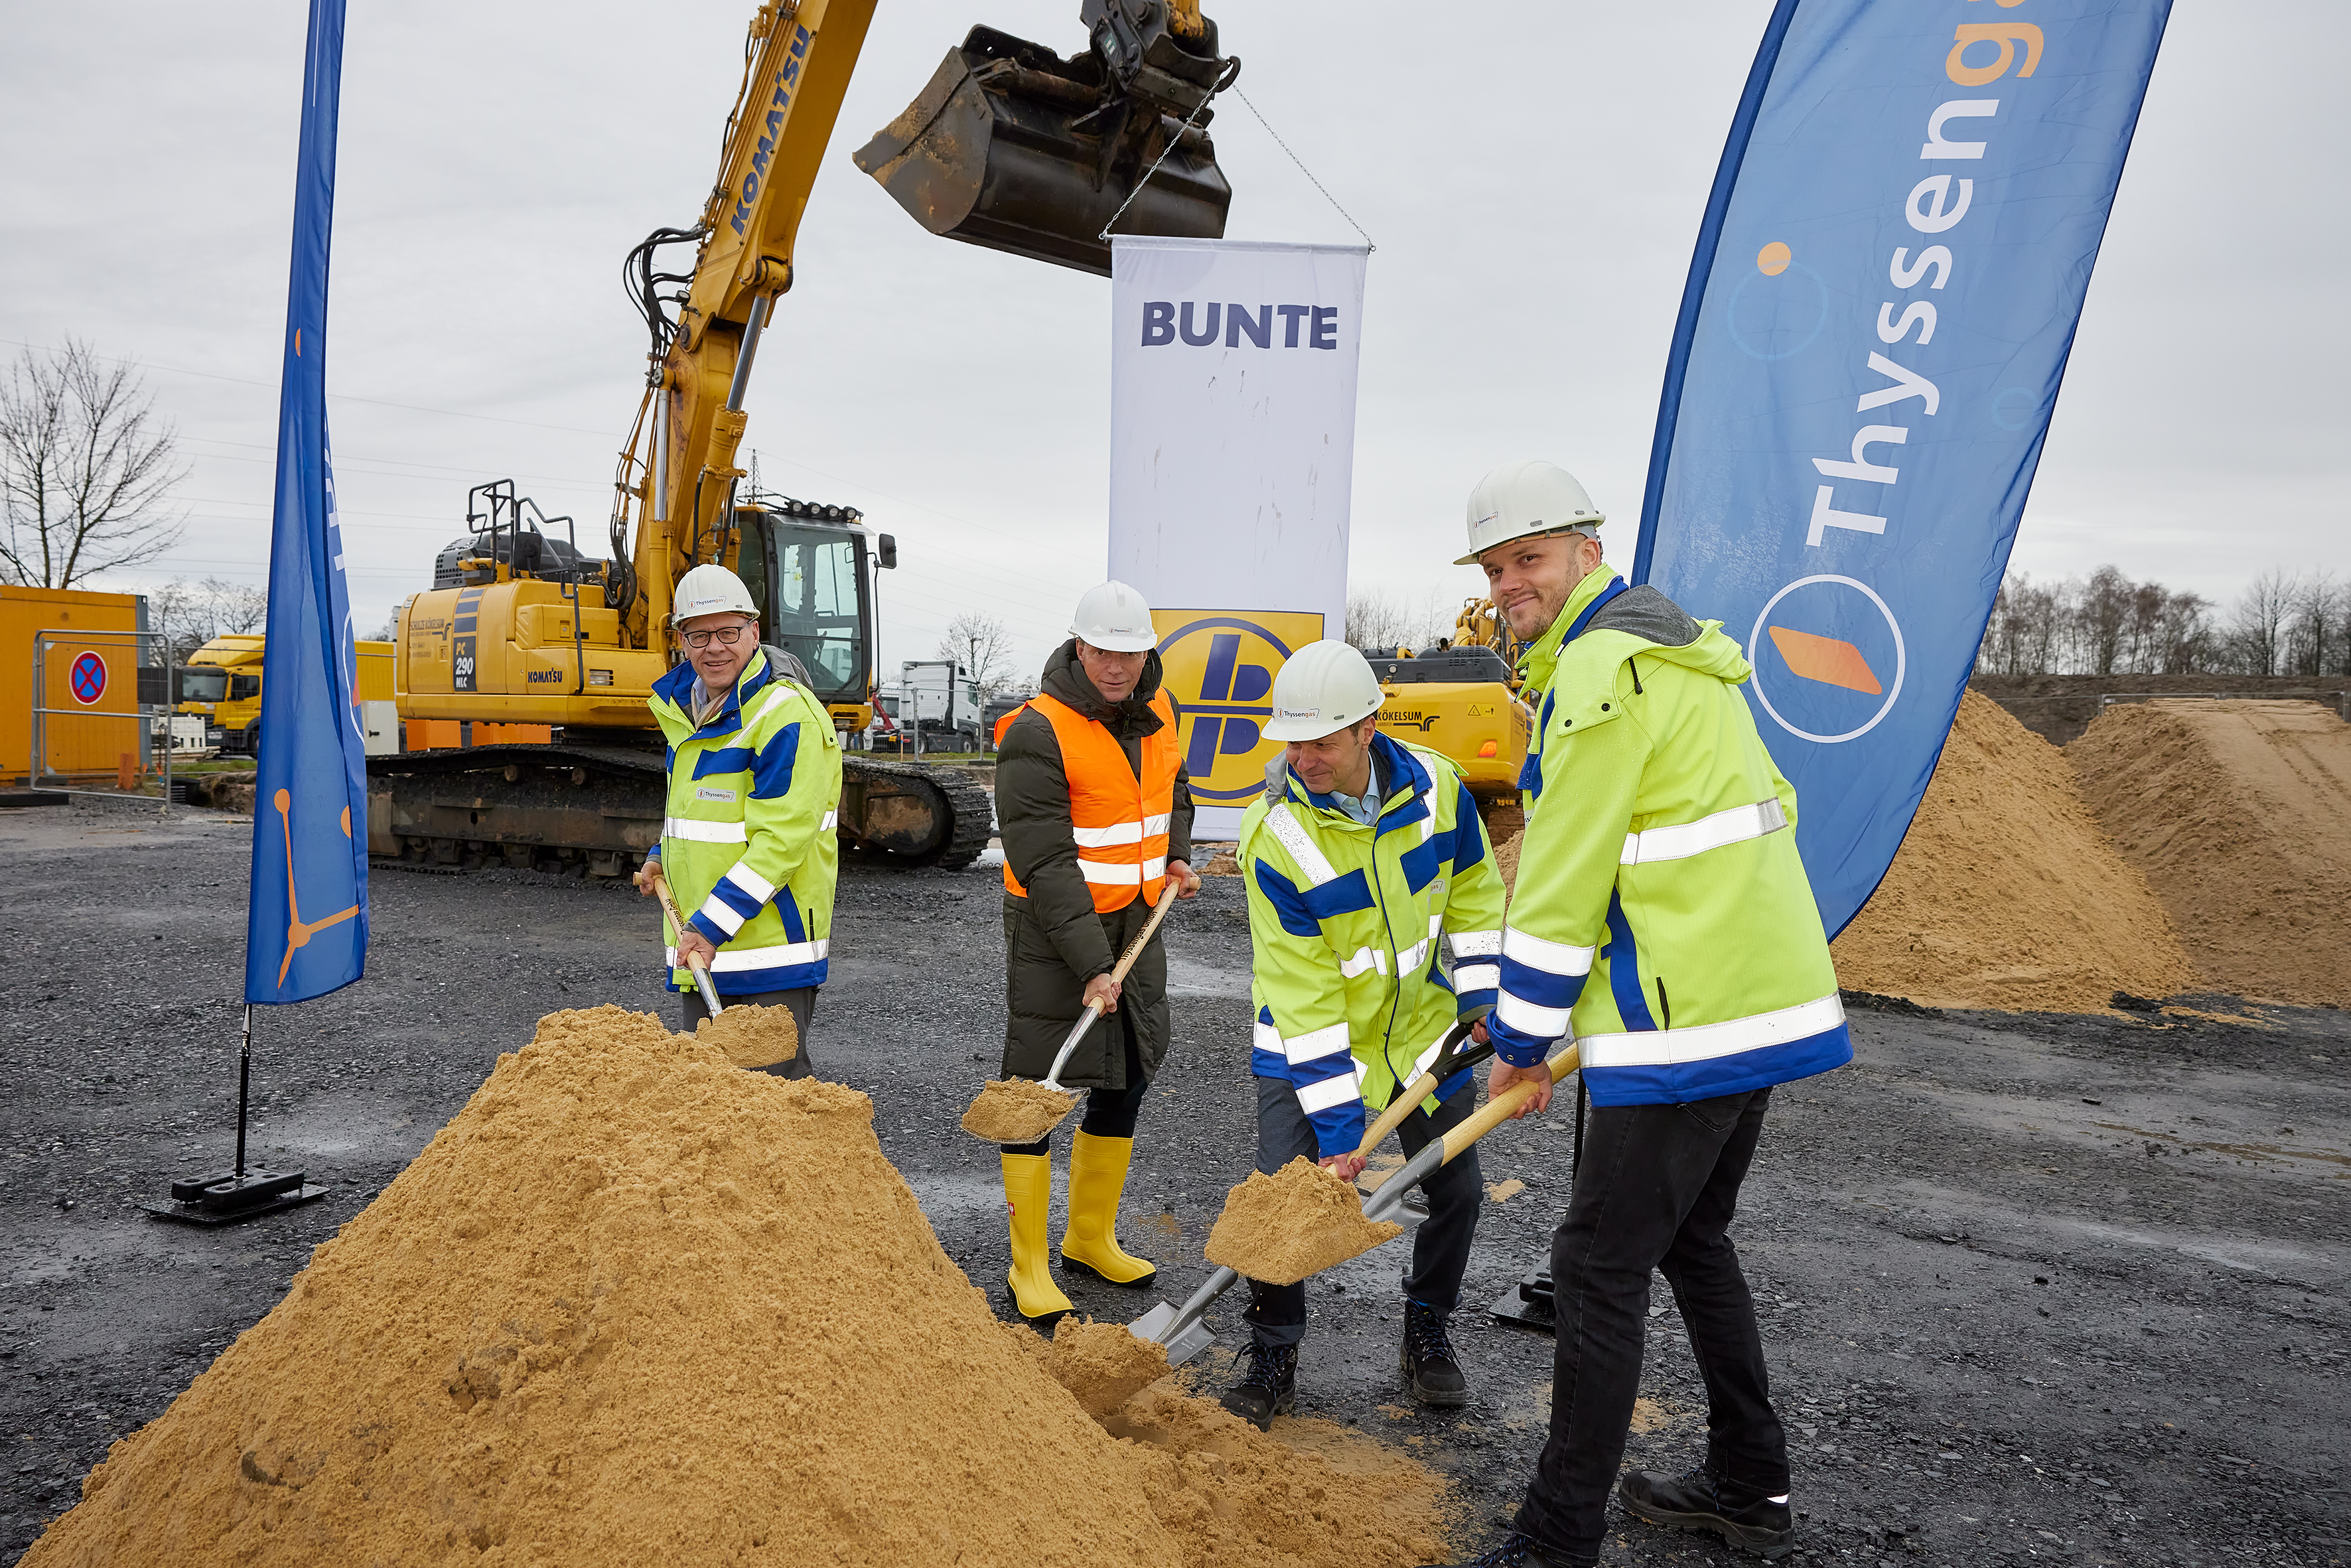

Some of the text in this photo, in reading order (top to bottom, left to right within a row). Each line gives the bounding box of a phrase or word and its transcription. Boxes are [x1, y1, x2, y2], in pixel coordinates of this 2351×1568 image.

[730, 24, 810, 238] KOMATSU
[1806, 0, 2044, 547] Thysseng
[1141, 301, 1338, 350] BUNTE
[456, 642, 466, 656] PC
[455, 656, 474, 676] 290
[456, 676, 468, 688] NLC
[528, 667, 563, 683] KOMATSU
[1377, 709, 1422, 721] KÖKELSUM
[705, 791, 731, 800] Thyssengas
